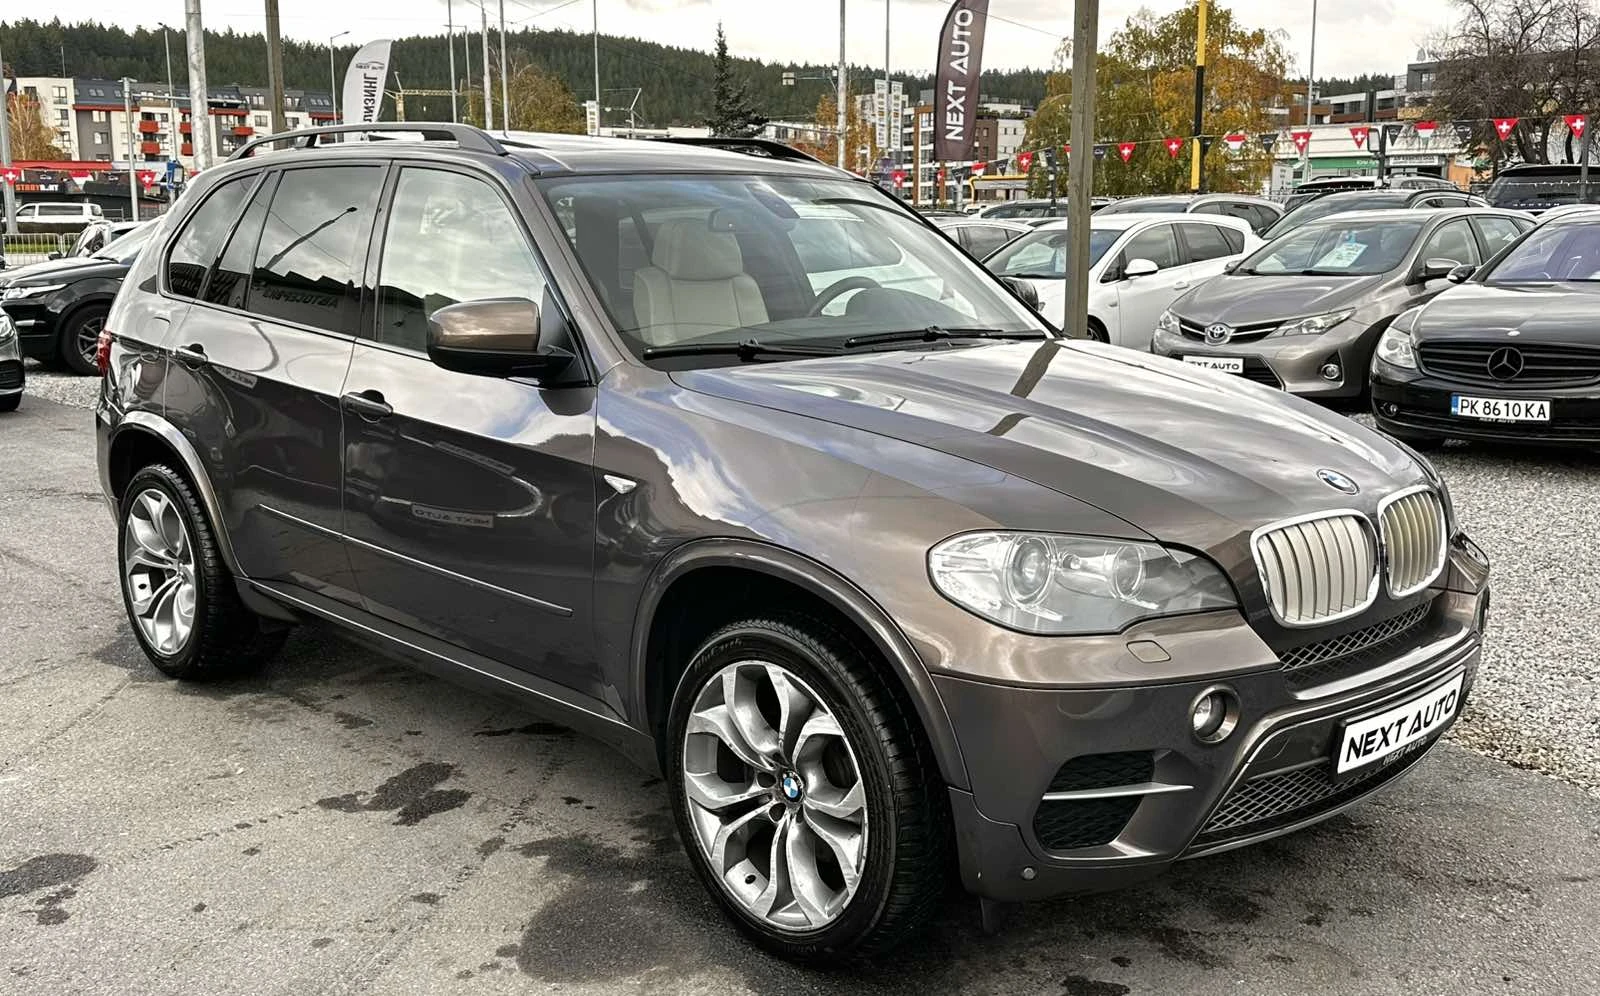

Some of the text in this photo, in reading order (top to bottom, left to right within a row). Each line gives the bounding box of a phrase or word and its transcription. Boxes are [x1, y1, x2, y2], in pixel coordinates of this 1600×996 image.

[945, 8, 974, 141] NEXT AUTO
[363, 73, 378, 122] ЛИЗИНГ
[1210, 362, 1240, 370] AUTO
[1460, 399, 1547, 418] PK 8610 KA
[1346, 688, 1457, 763] NEXT AUTO
[1382, 735, 1428, 766] NEXT AUTO
